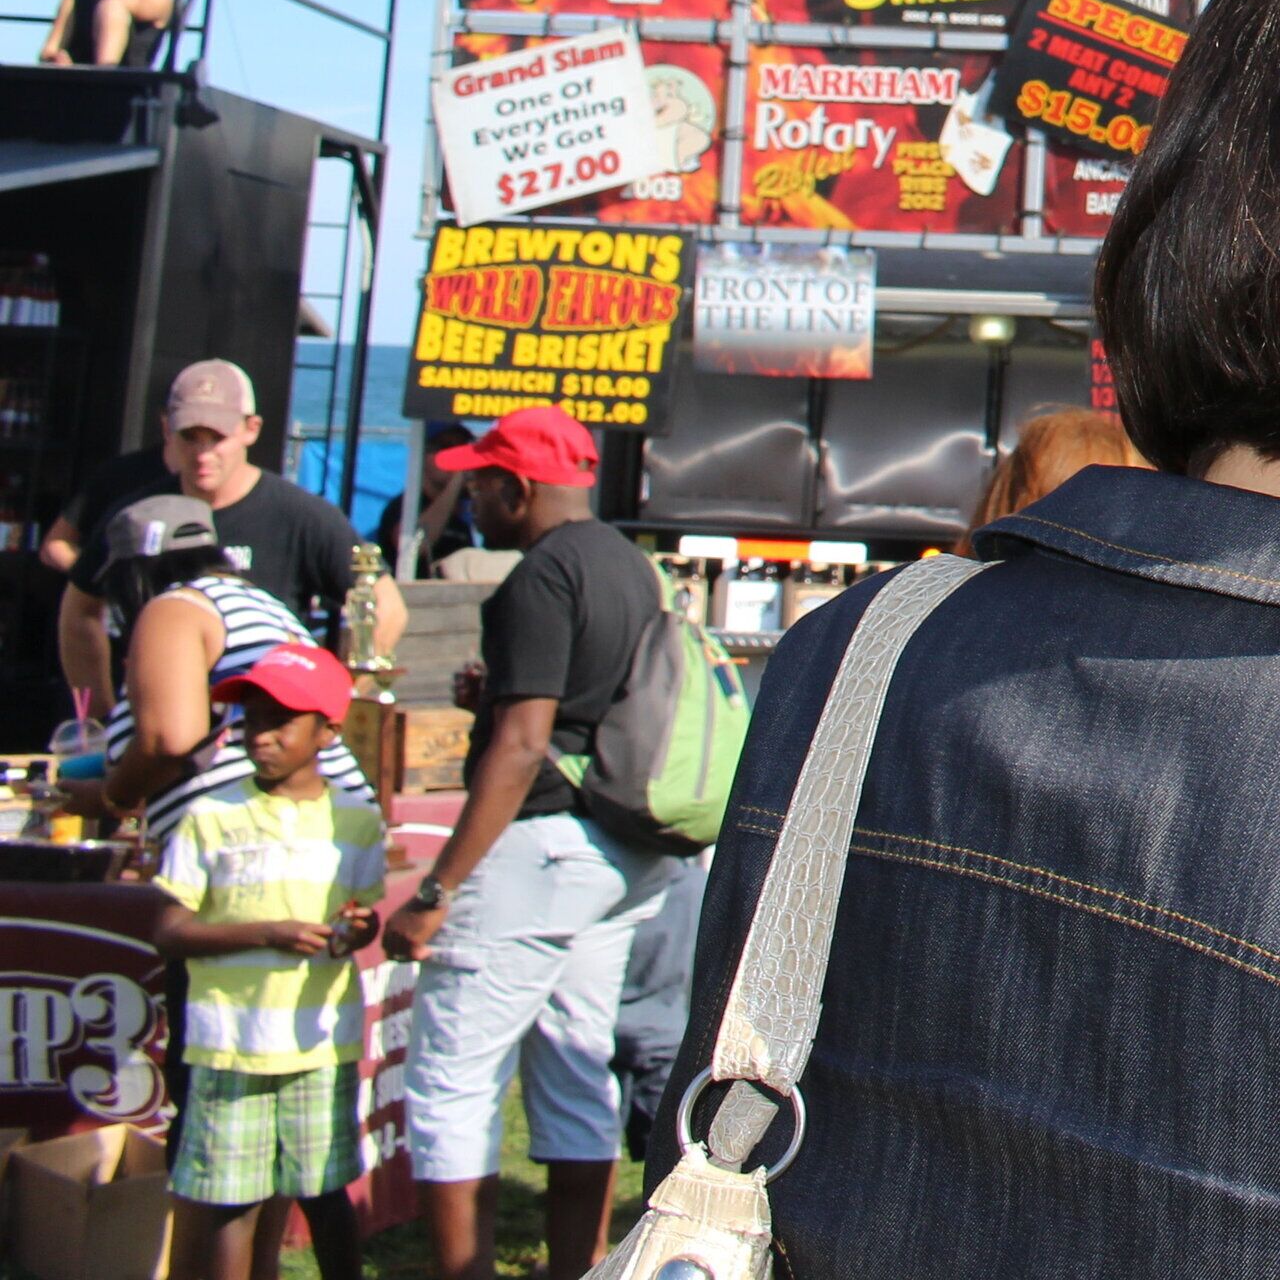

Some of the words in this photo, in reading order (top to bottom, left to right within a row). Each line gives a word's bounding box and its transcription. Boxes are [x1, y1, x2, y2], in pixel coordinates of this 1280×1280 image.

[453, 57, 547, 99] Grand
[554, 40, 626, 74] Slam
[1027, 28, 1048, 51] 2
[1047, 34, 1110, 74] MEAT
[494, 85, 553, 118] One
[559, 79, 597, 103] Of
[761, 64, 957, 104] MARKHAM
[1114, 87, 1137, 109] 2
[472, 96, 628, 147] Everything
[502, 138, 549, 164] We
[556, 124, 607, 151] Got
[754, 103, 897, 168] Rotary
[496, 149, 622, 207] $27.00
[432, 227, 683, 283] BREWTON'S
[428, 265, 543, 329] WORLD
[541, 266, 681, 330] FAMOUS
[701, 276, 818, 304] FRONT
[823, 279, 872, 306] OF
[701, 304, 780, 332] THE
[790, 307, 870, 333] LINE
[416, 311, 506, 365] BEEF
[512, 324, 671, 373] BRISKET
[419, 365, 556, 393] SANDWICH
[561, 373, 650, 399] $10.00
